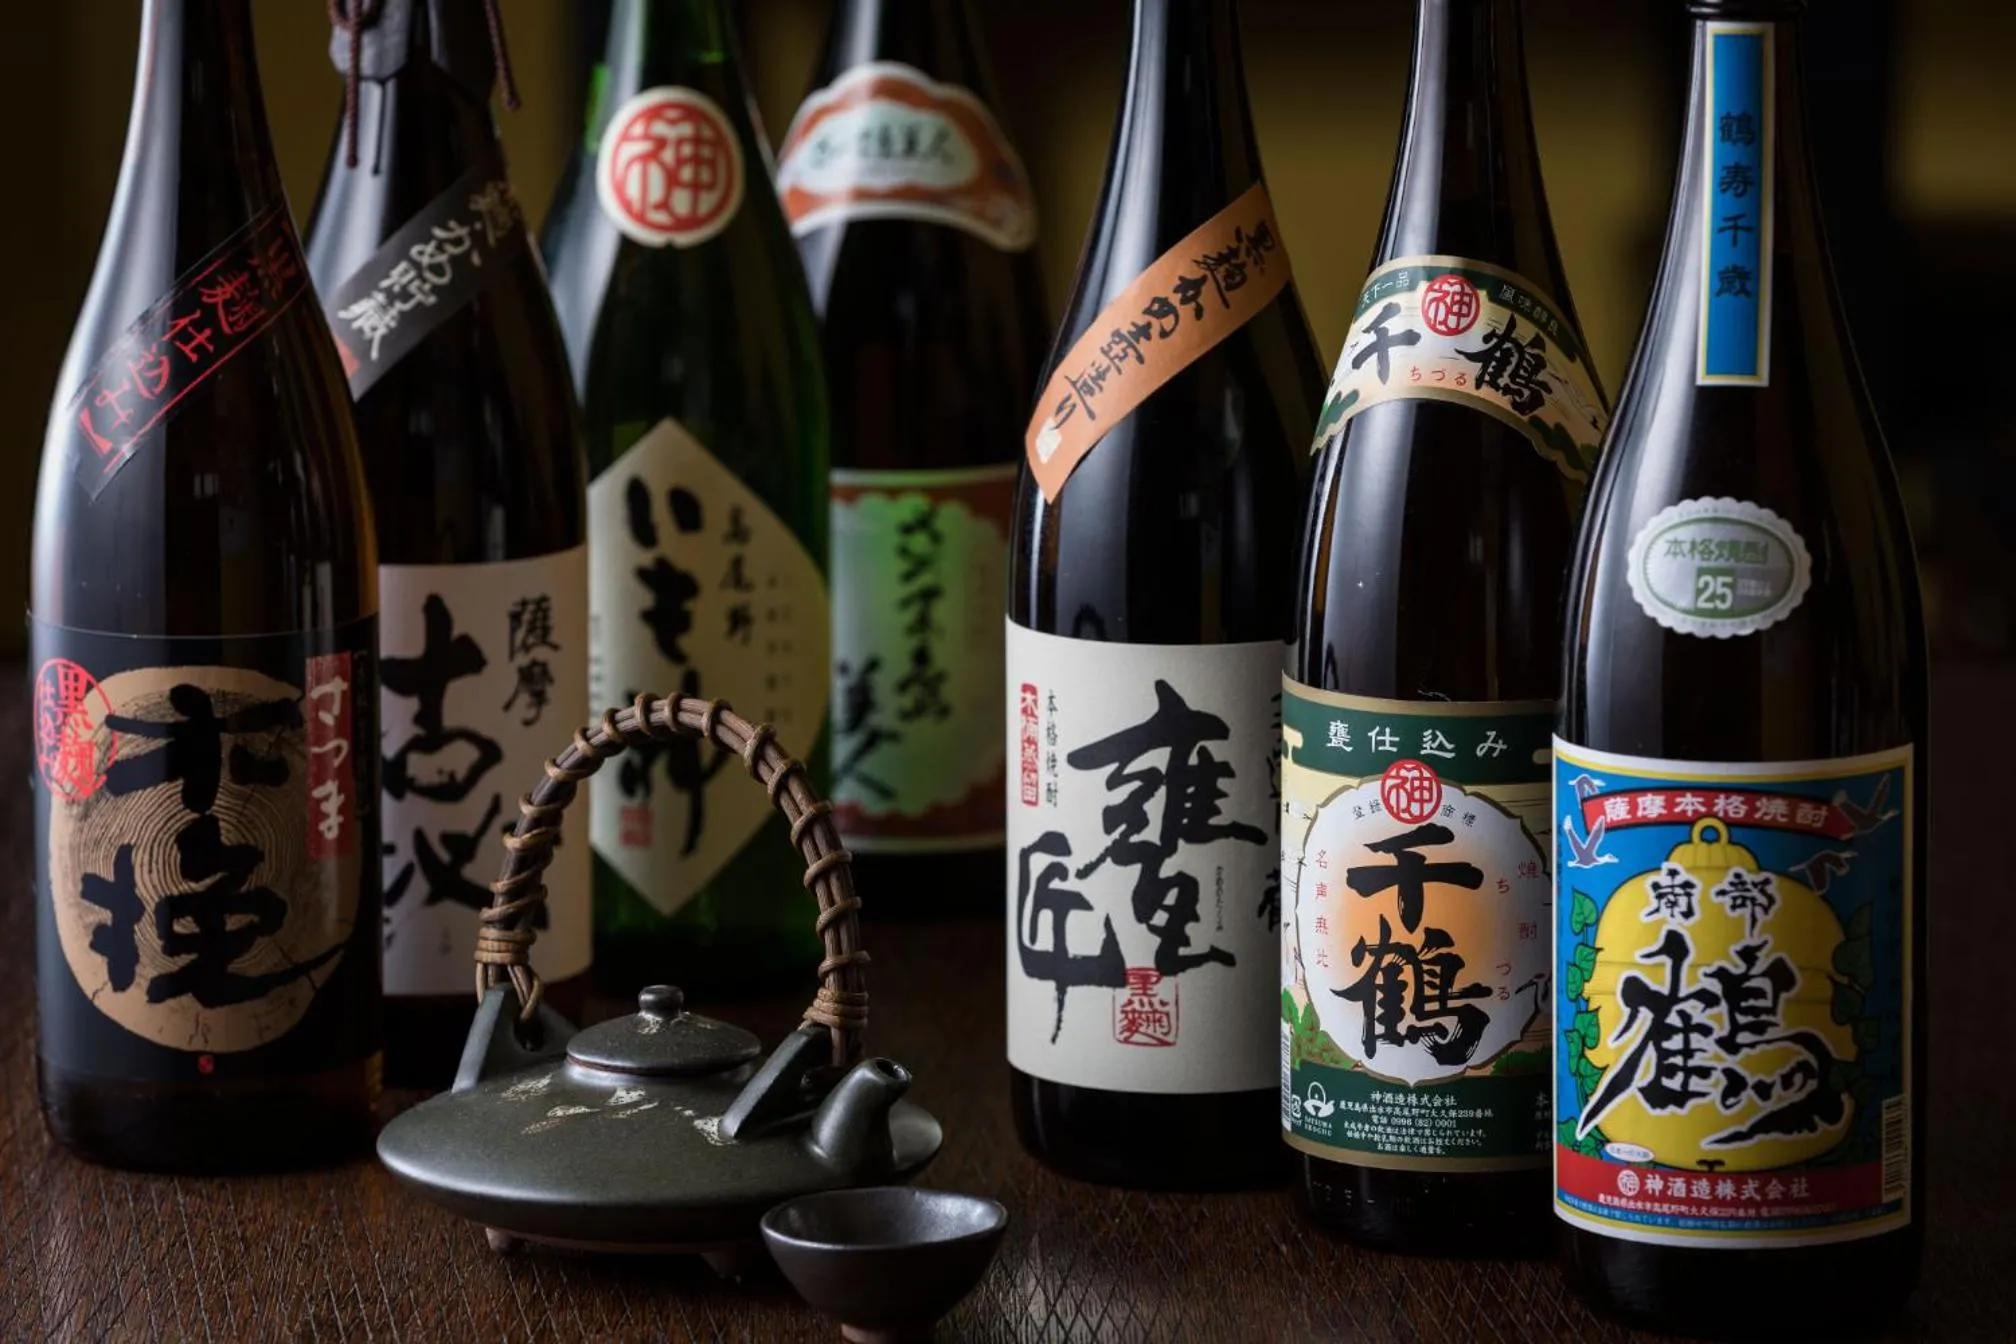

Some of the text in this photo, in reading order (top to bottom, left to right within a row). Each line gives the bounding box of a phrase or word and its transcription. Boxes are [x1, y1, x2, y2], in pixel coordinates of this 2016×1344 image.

[1715, 111, 1756, 298] 鶴寿千歳
[1351, 302, 1554, 417] 千鶴
[1409, 364, 1467, 387] ちづる
[719, 504, 756, 646] 高尾野
[1696, 575, 1733, 610] 25
[503, 593, 561, 727] 薩摩
[309, 675, 350, 840] さつま
[1326, 719, 1508, 759] 甕仕込み
[1603, 792, 1830, 829] 薩摩本格焼酎
[1330, 822, 1493, 1066] 千鶴
[1644, 1173, 1811, 1201] 神酒造株式会社
